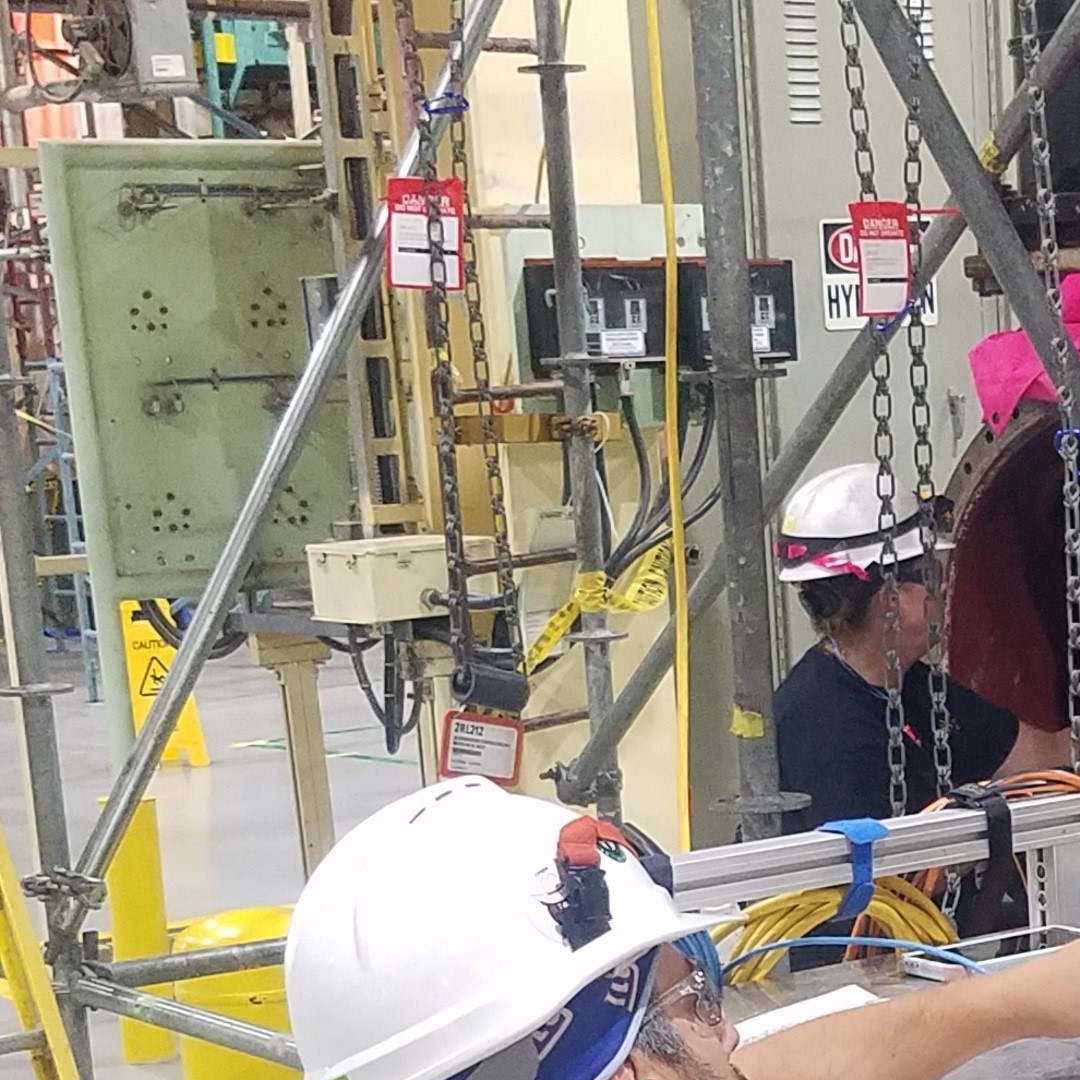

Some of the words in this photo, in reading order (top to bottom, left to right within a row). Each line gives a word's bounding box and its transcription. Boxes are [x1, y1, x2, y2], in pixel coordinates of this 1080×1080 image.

[401, 193, 451, 207] DANR
[862, 218, 900, 230] DANGER
[132, 639, 168, 650] CAUTIO
